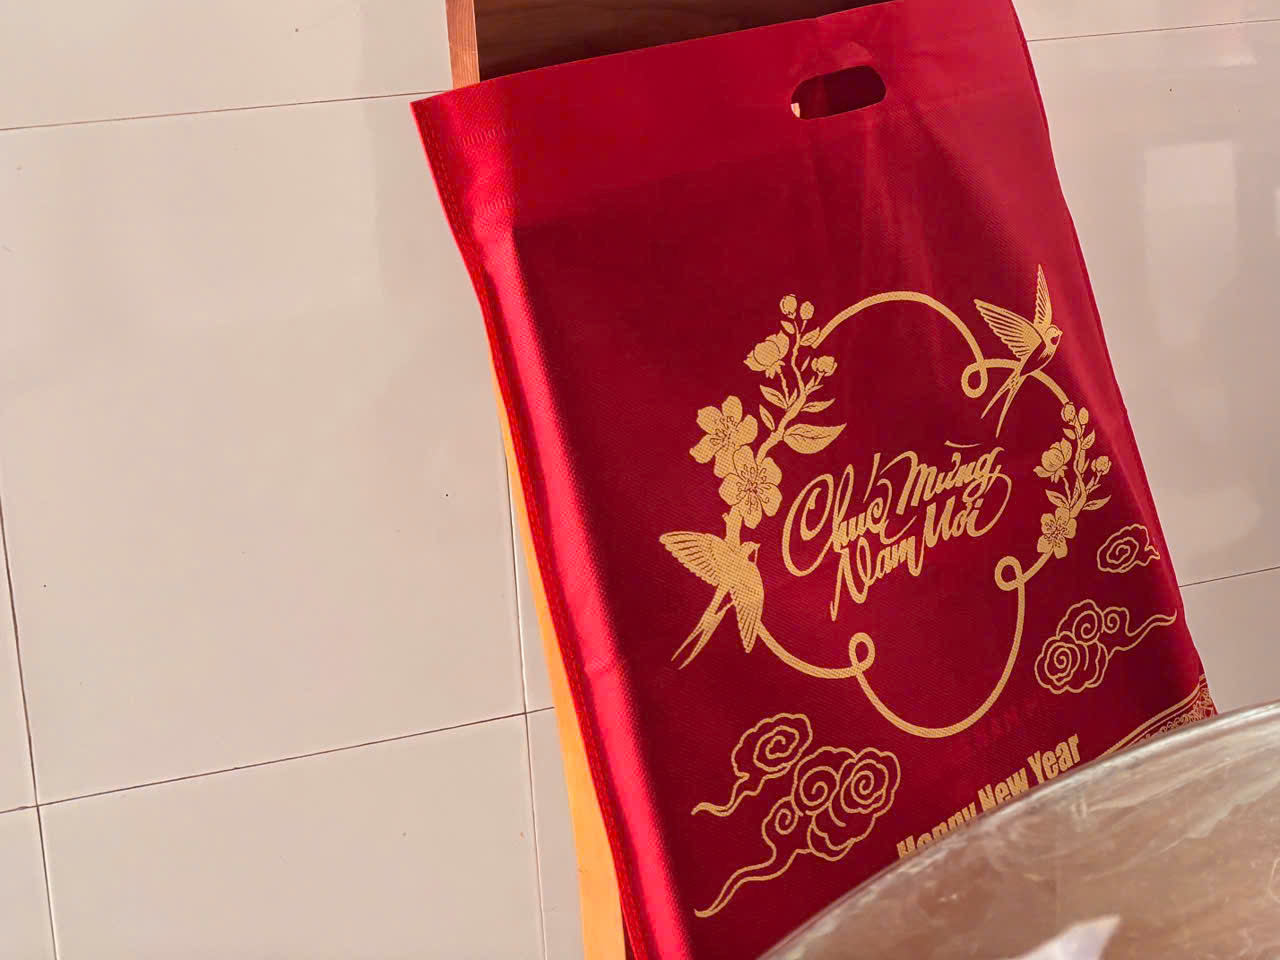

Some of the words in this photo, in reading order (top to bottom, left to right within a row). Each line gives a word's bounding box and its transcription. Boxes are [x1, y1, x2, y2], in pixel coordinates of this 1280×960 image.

[782, 452, 893, 577] Chúc
[977, 767, 1030, 812] New
[1027, 733, 1081, 784] Year
